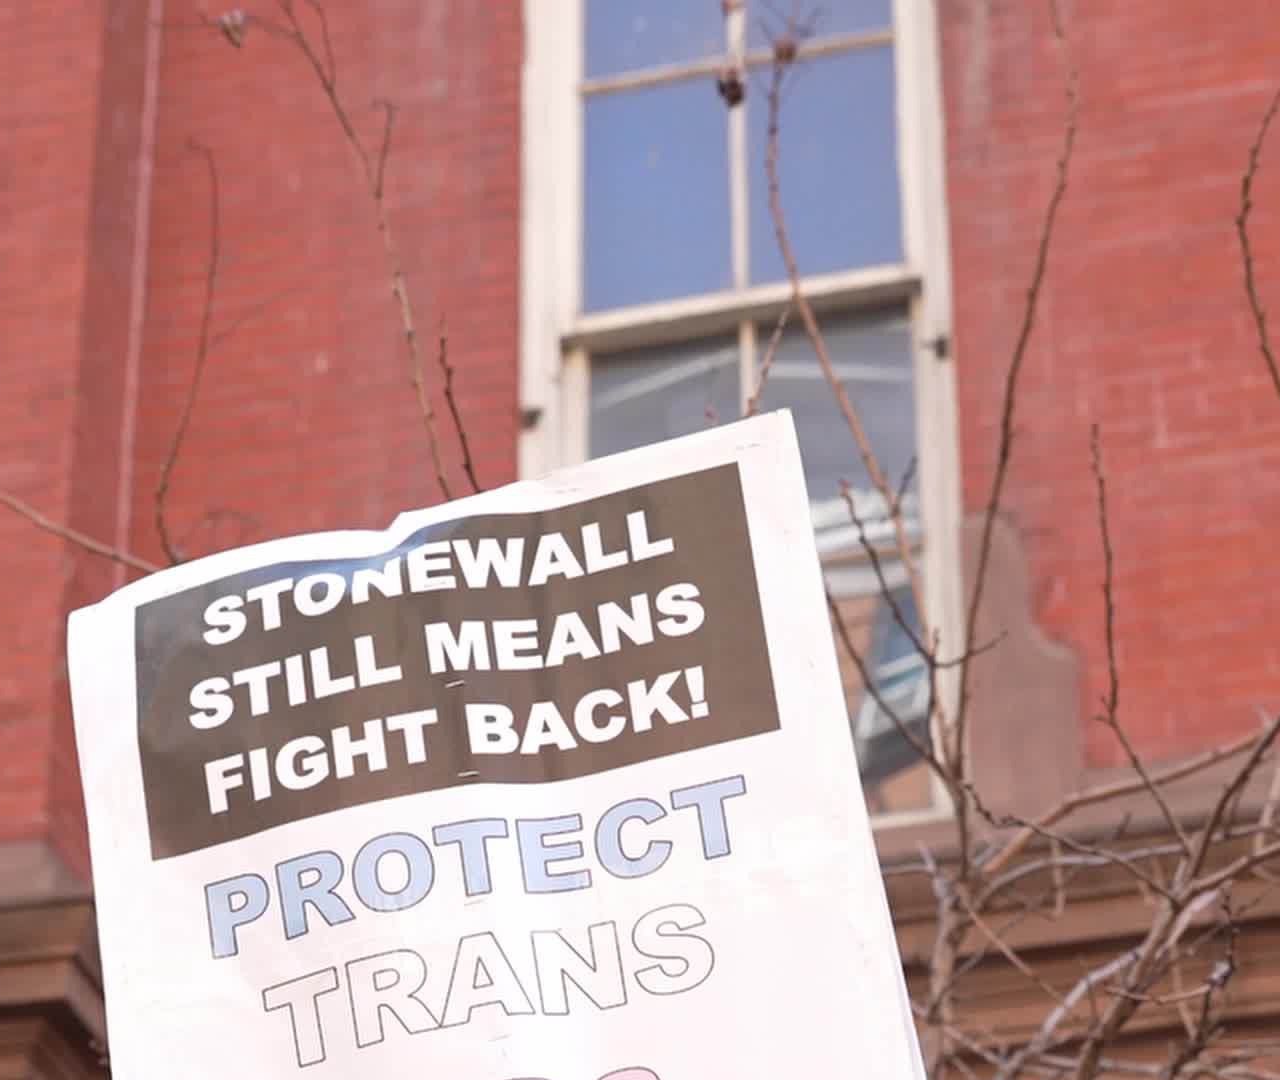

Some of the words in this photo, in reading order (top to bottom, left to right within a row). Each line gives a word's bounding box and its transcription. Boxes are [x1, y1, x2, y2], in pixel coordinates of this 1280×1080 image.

[203, 511, 673, 646] STONEWALL
[189, 636, 402, 730] STILL
[424, 583, 706, 674] MEANS
[204, 708, 438, 815] FIGHT
[465, 666, 710, 755] BACK!
[204, 775, 746, 959] PROTECT
[262, 904, 715, 1068] TRANS
